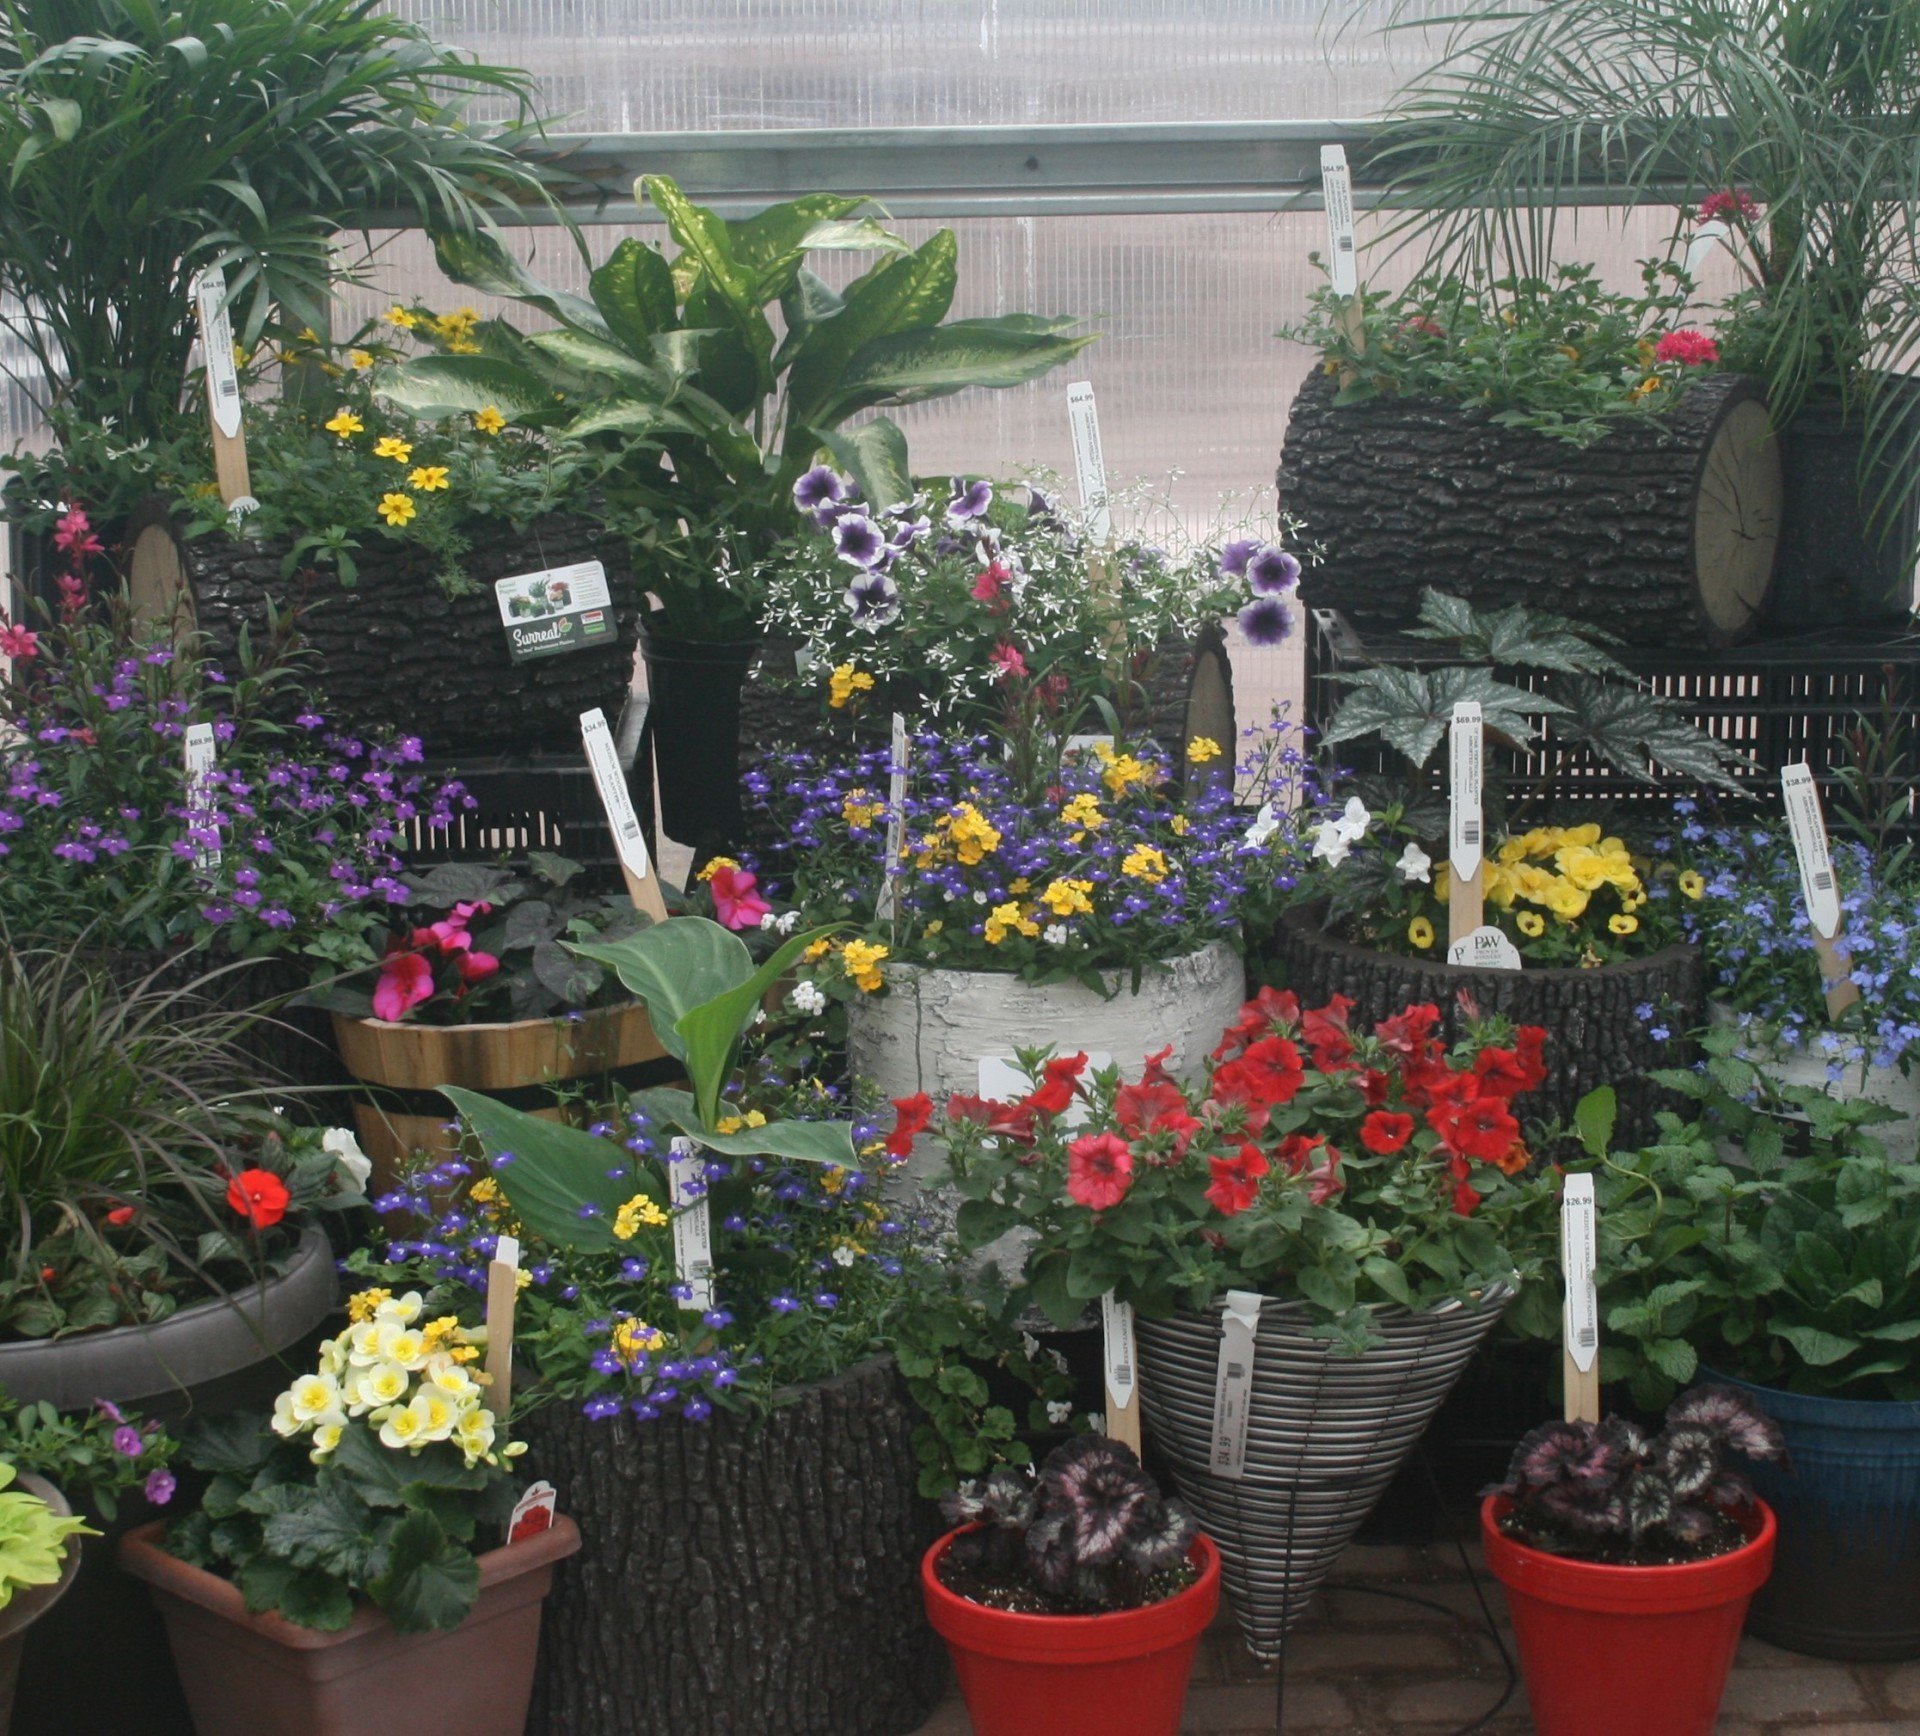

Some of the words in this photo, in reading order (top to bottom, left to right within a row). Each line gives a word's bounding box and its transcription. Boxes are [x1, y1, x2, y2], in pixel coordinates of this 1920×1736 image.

[1322, 164, 1344, 172] $64.99
[1070, 393, 1093, 403] $64.99
[513, 622, 562, 646] Surreal
[1785, 775, 1811, 786] $38.99
[1474, 935, 1501, 949] PW
[1566, 1197, 1591, 1205] $26.99
[1118, 1319, 1131, 1363] CONTAINER
[1216, 1436, 1233, 1465] $34.99
